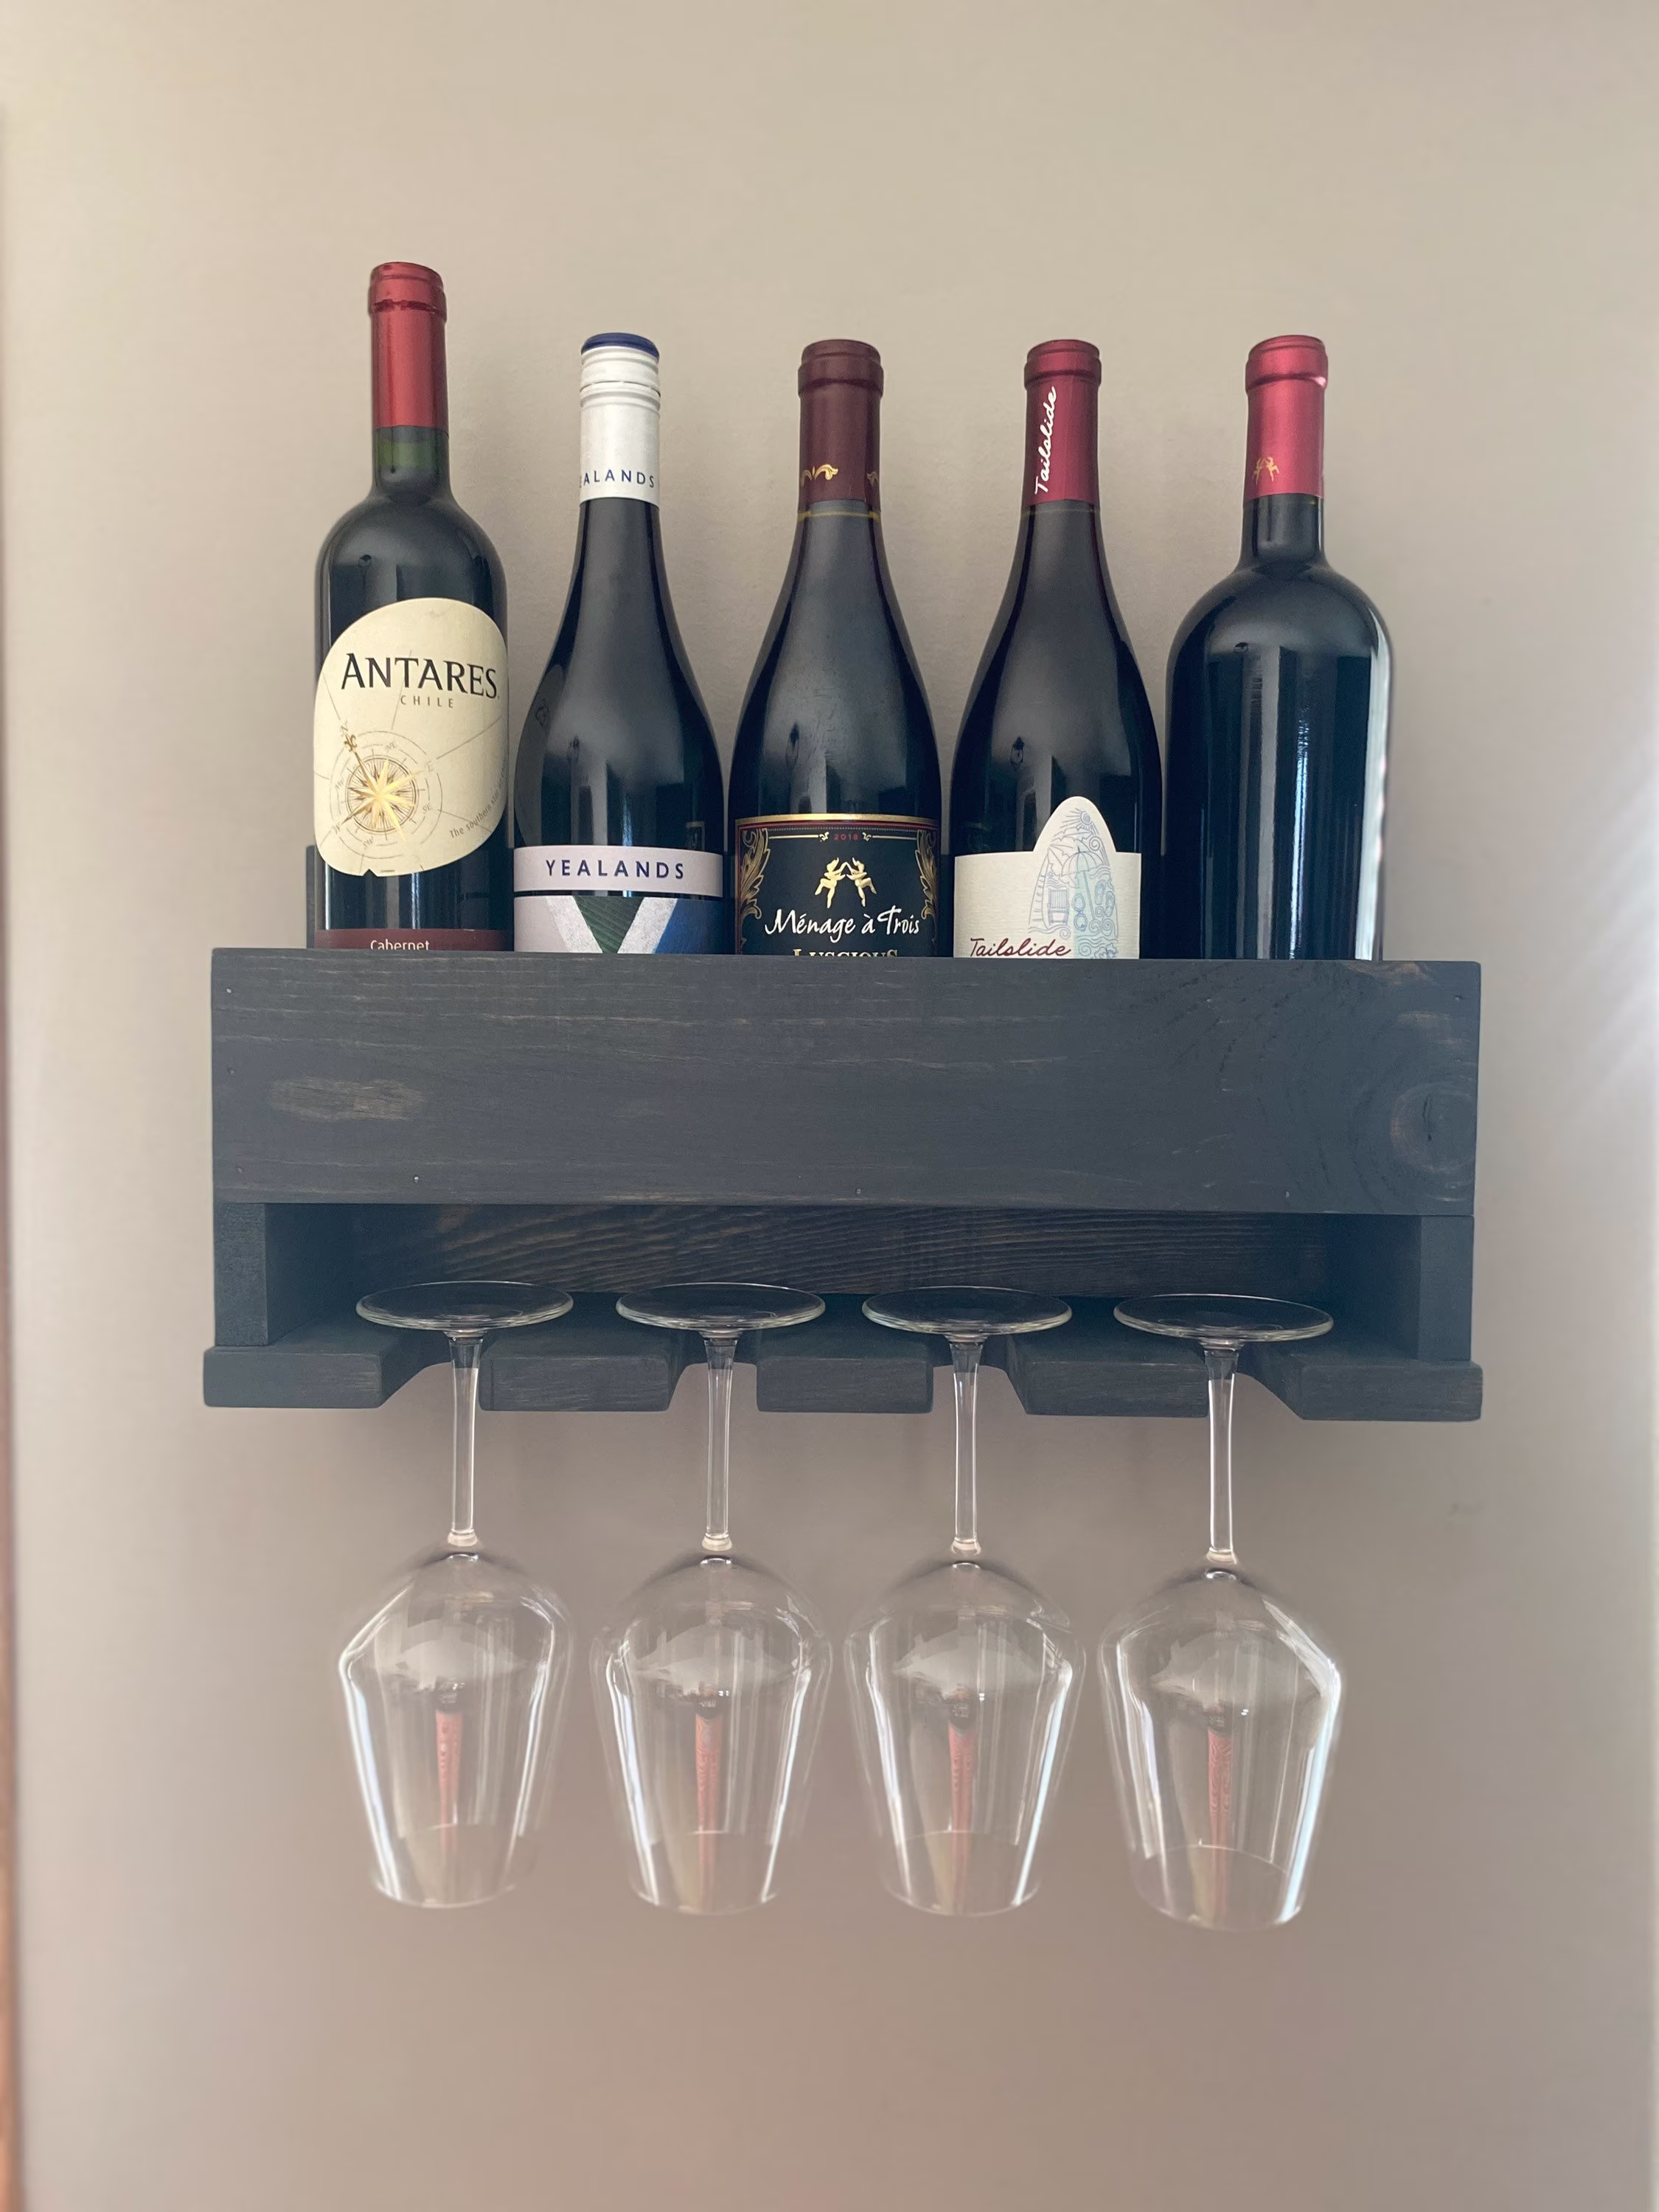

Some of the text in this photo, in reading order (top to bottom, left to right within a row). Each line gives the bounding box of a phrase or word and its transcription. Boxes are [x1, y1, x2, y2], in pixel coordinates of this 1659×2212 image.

[1034, 386, 1057, 495] Tailslide
[580, 469, 655, 488] ALANDS
[341, 653, 498, 700] ANTARES
[400, 695, 454, 709] CHILE
[449, 826, 465, 838] The
[466, 804, 492, 830] southern
[834, 833, 859, 841] 2018
[546, 860, 684, 880] YEALANDS
[765, 905, 919, 943] Ménage à Trois
[370, 939, 430, 950] Cabernet
[970, 937, 1071, 957] Tailslide
